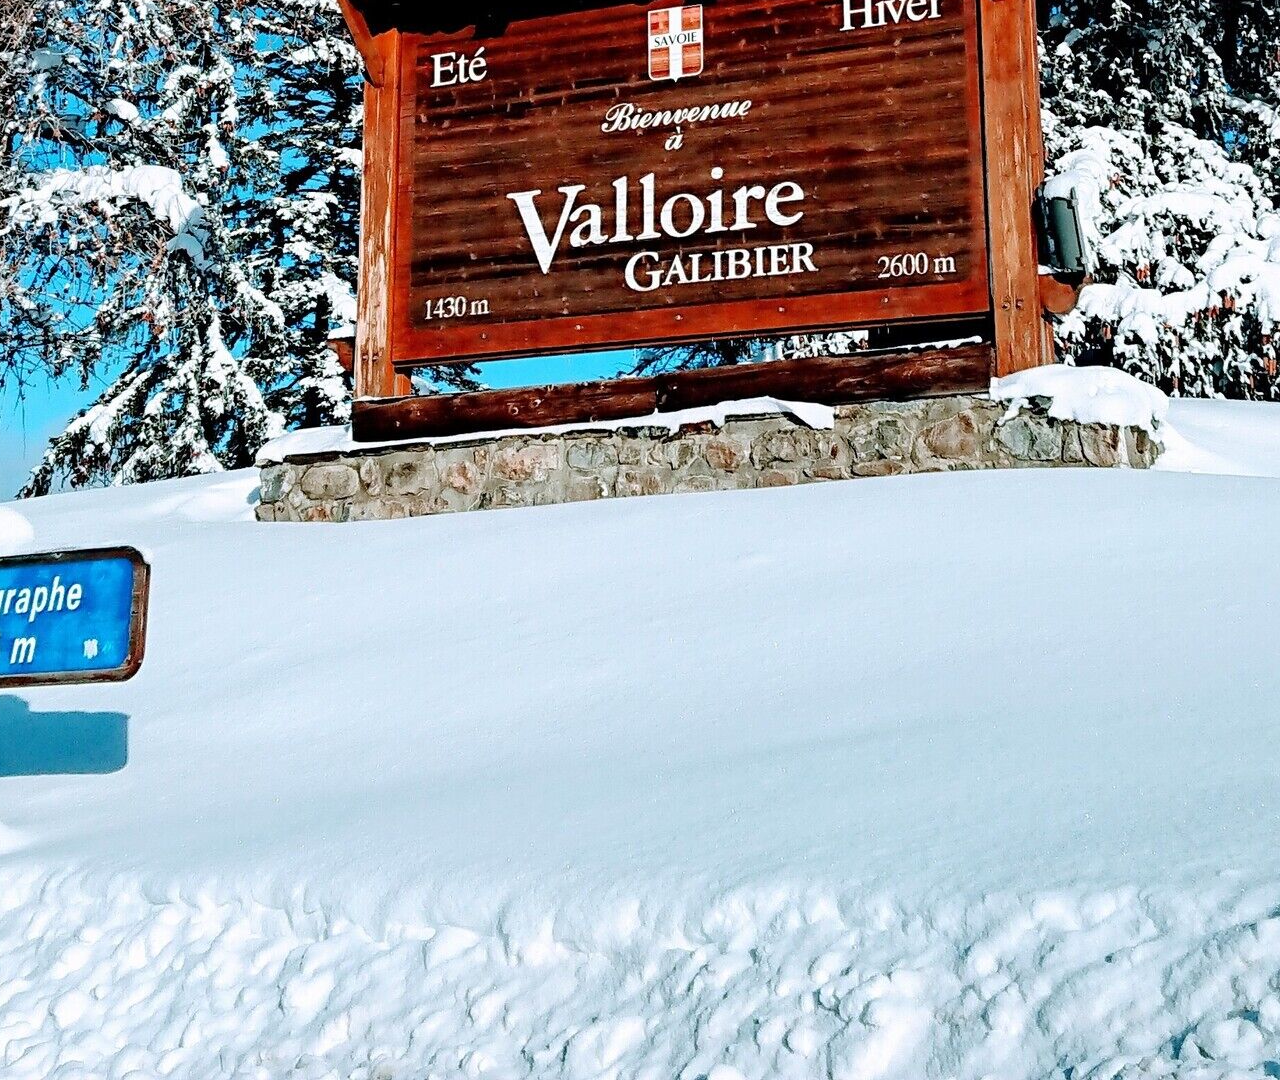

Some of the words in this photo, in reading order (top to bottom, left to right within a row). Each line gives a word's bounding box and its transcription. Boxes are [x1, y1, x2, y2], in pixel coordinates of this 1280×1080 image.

[654, 32, 697, 47] SAVOIE
[430, 46, 487, 87] Eté
[601, 100, 752, 132] Bienvenue
[664, 127, 683, 151] à
[506, 166, 805, 274] Valloire
[624, 242, 819, 292] GALIBIER
[878, 252, 928, 278] 2600
[933, 256, 956, 273] m
[425, 296, 467, 320] 1430
[470, 299, 490, 315] m
[10, 636, 37, 664] m
